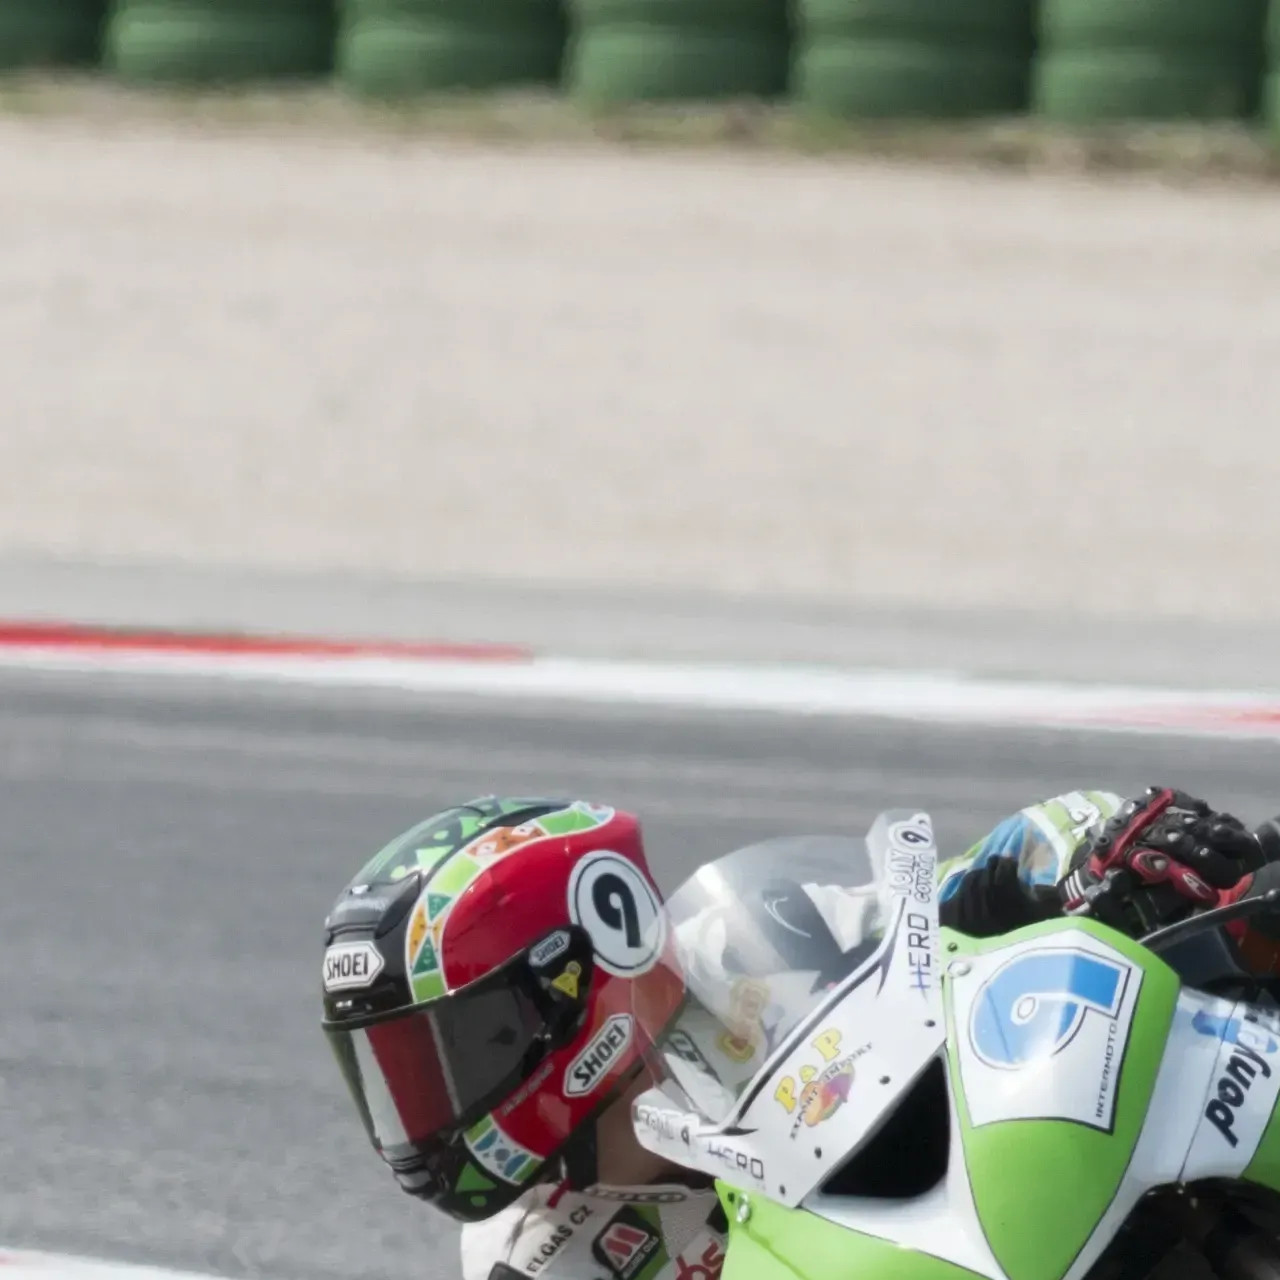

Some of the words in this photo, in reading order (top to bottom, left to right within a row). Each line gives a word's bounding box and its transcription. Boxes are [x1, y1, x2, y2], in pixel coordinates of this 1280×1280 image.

[534, 935, 565, 961] SHOEI
[591, 872, 642, 949] 9
[326, 951, 370, 980] SHOEI
[907, 912, 931, 990] HERO
[968, 946, 1132, 1071] 9
[573, 1022, 628, 1088] SHOEI
[1095, 1022, 1118, 1119] INTERMOTO
